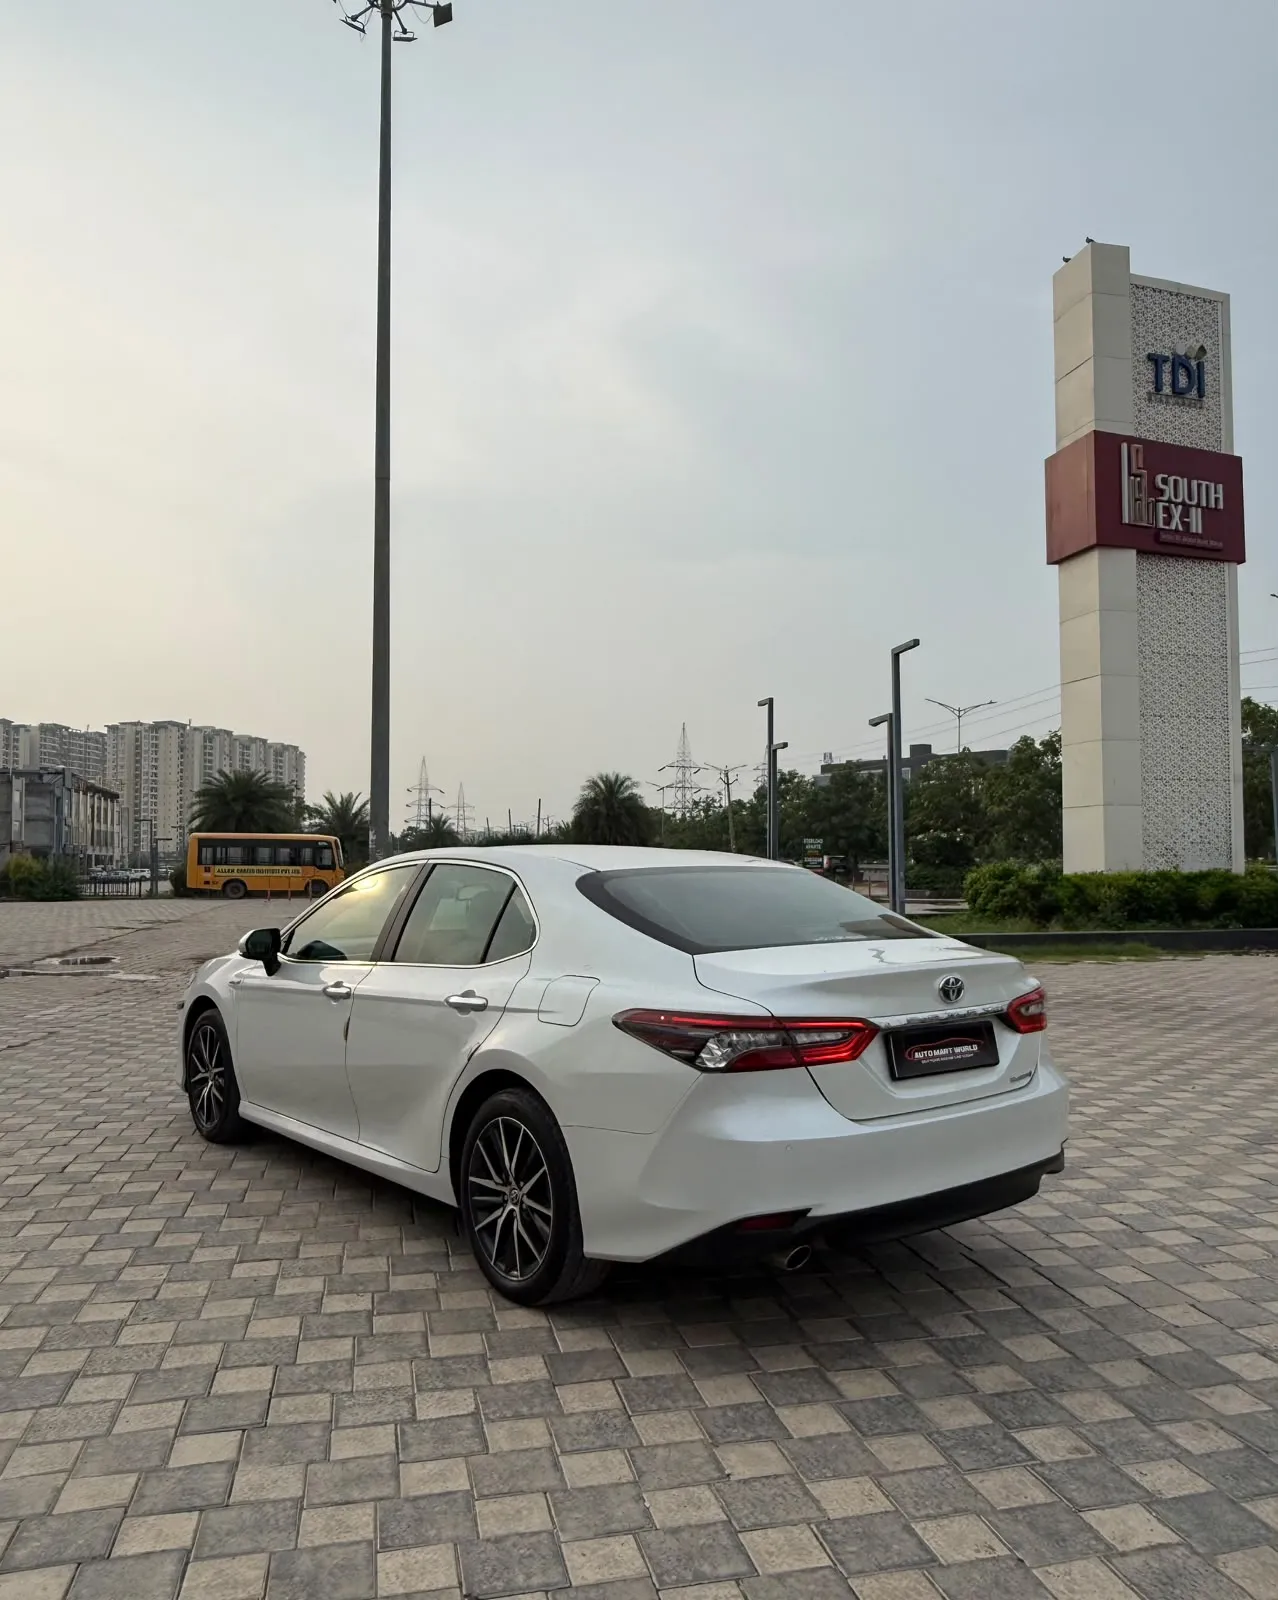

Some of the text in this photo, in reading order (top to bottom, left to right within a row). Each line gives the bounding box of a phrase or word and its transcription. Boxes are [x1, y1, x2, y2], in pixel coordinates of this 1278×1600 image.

[1147, 353, 1205, 398] TDI
[1155, 473, 1224, 510] SOUTH
[1156, 502, 1203, 534] EX-II
[953, 1044, 978, 1053] WORLD
